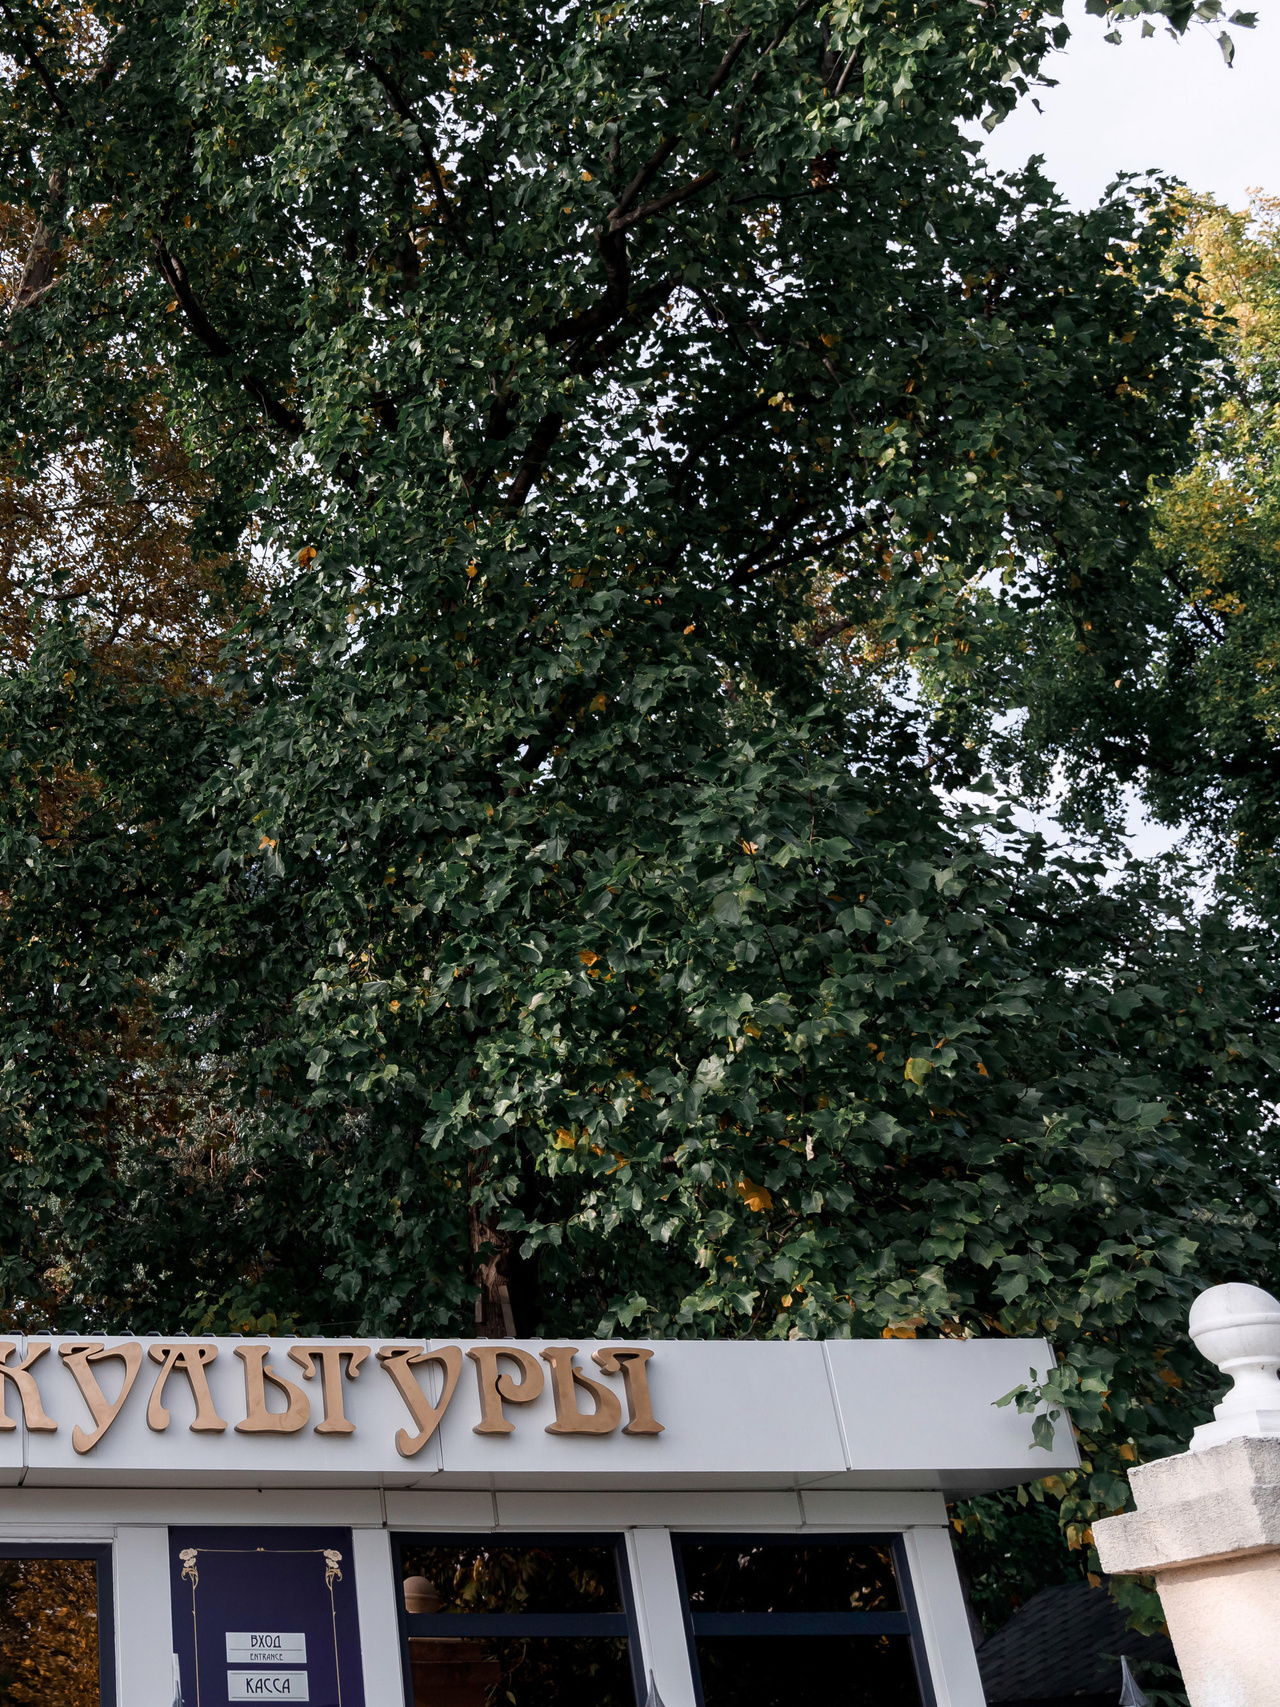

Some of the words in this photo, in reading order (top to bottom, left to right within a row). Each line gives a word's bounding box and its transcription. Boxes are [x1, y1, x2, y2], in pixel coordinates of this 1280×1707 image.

[250, 1634, 282, 1648] ВХОД
[250, 1653, 284, 1661] ENTRANCE
[246, 1678, 291, 1694] КАССА
